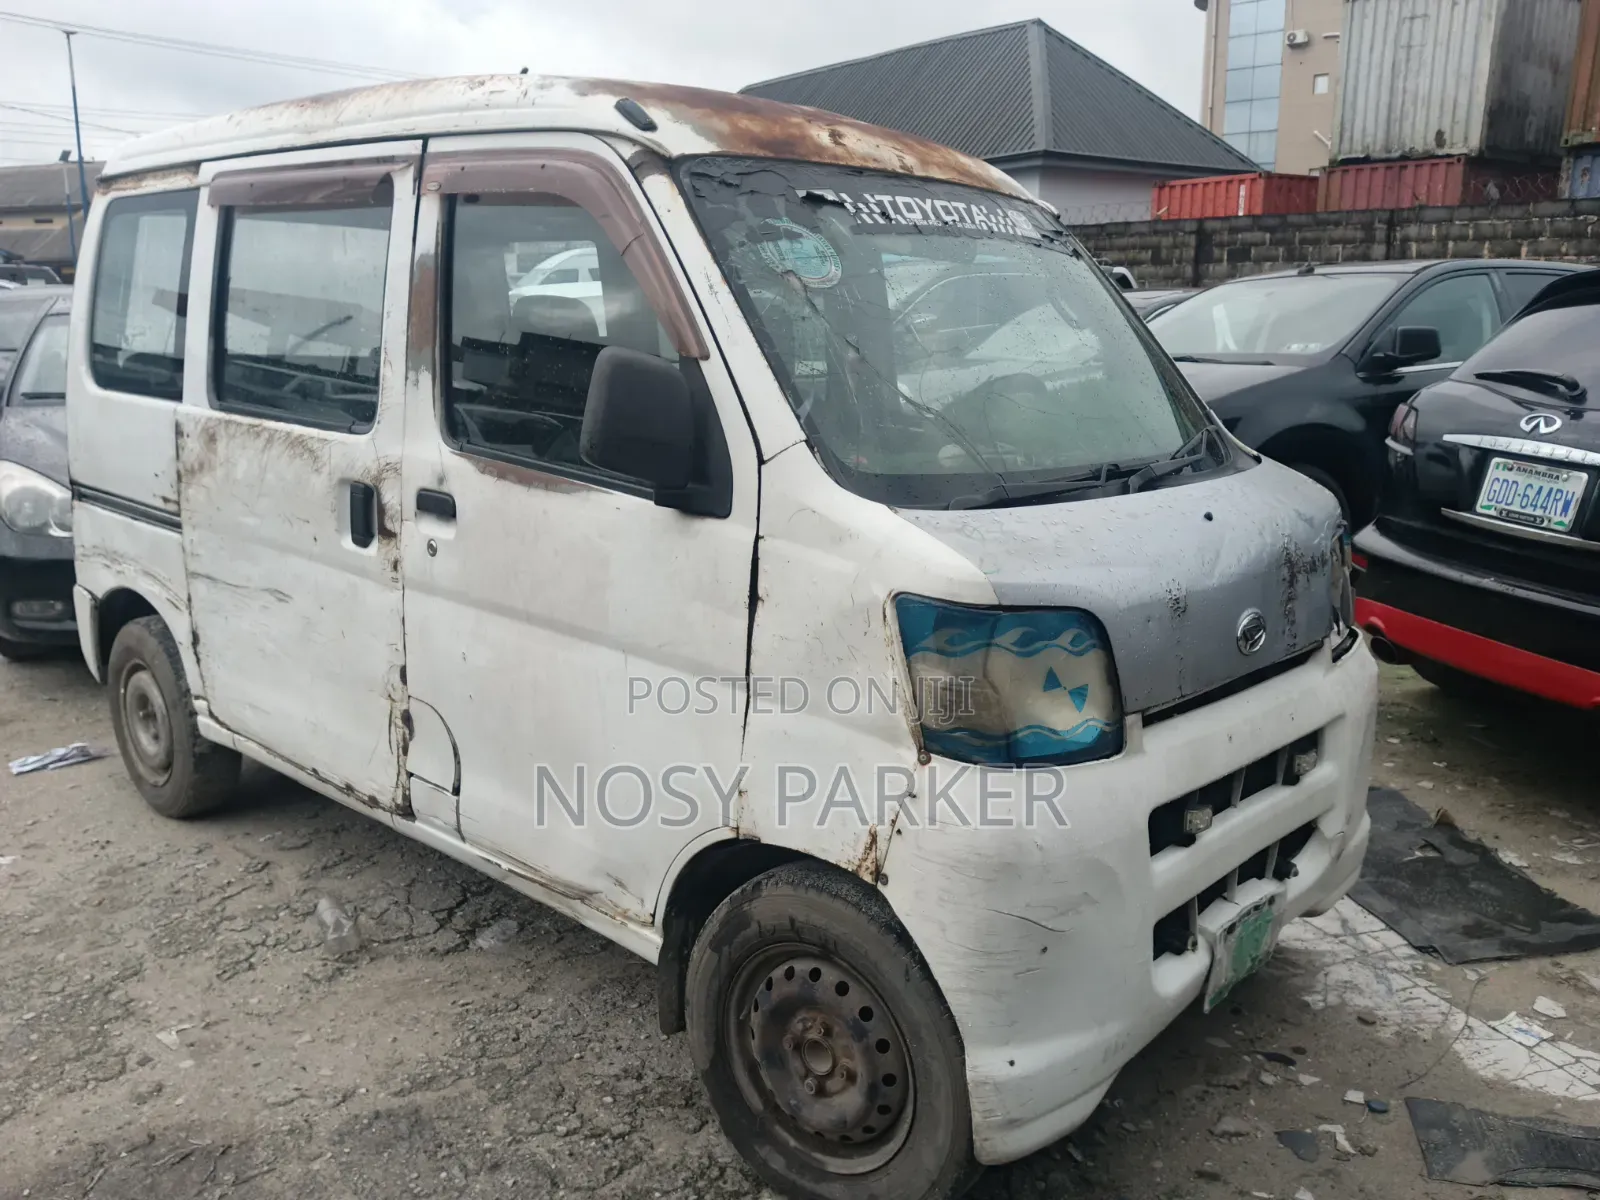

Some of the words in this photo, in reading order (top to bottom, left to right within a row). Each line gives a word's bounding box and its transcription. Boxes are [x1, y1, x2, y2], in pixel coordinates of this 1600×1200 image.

[875, 194, 986, 226] TOYOTA
[1515, 466, 1560, 481] ANAMBRA
[1486, 477, 1576, 518] GDD-644RW
